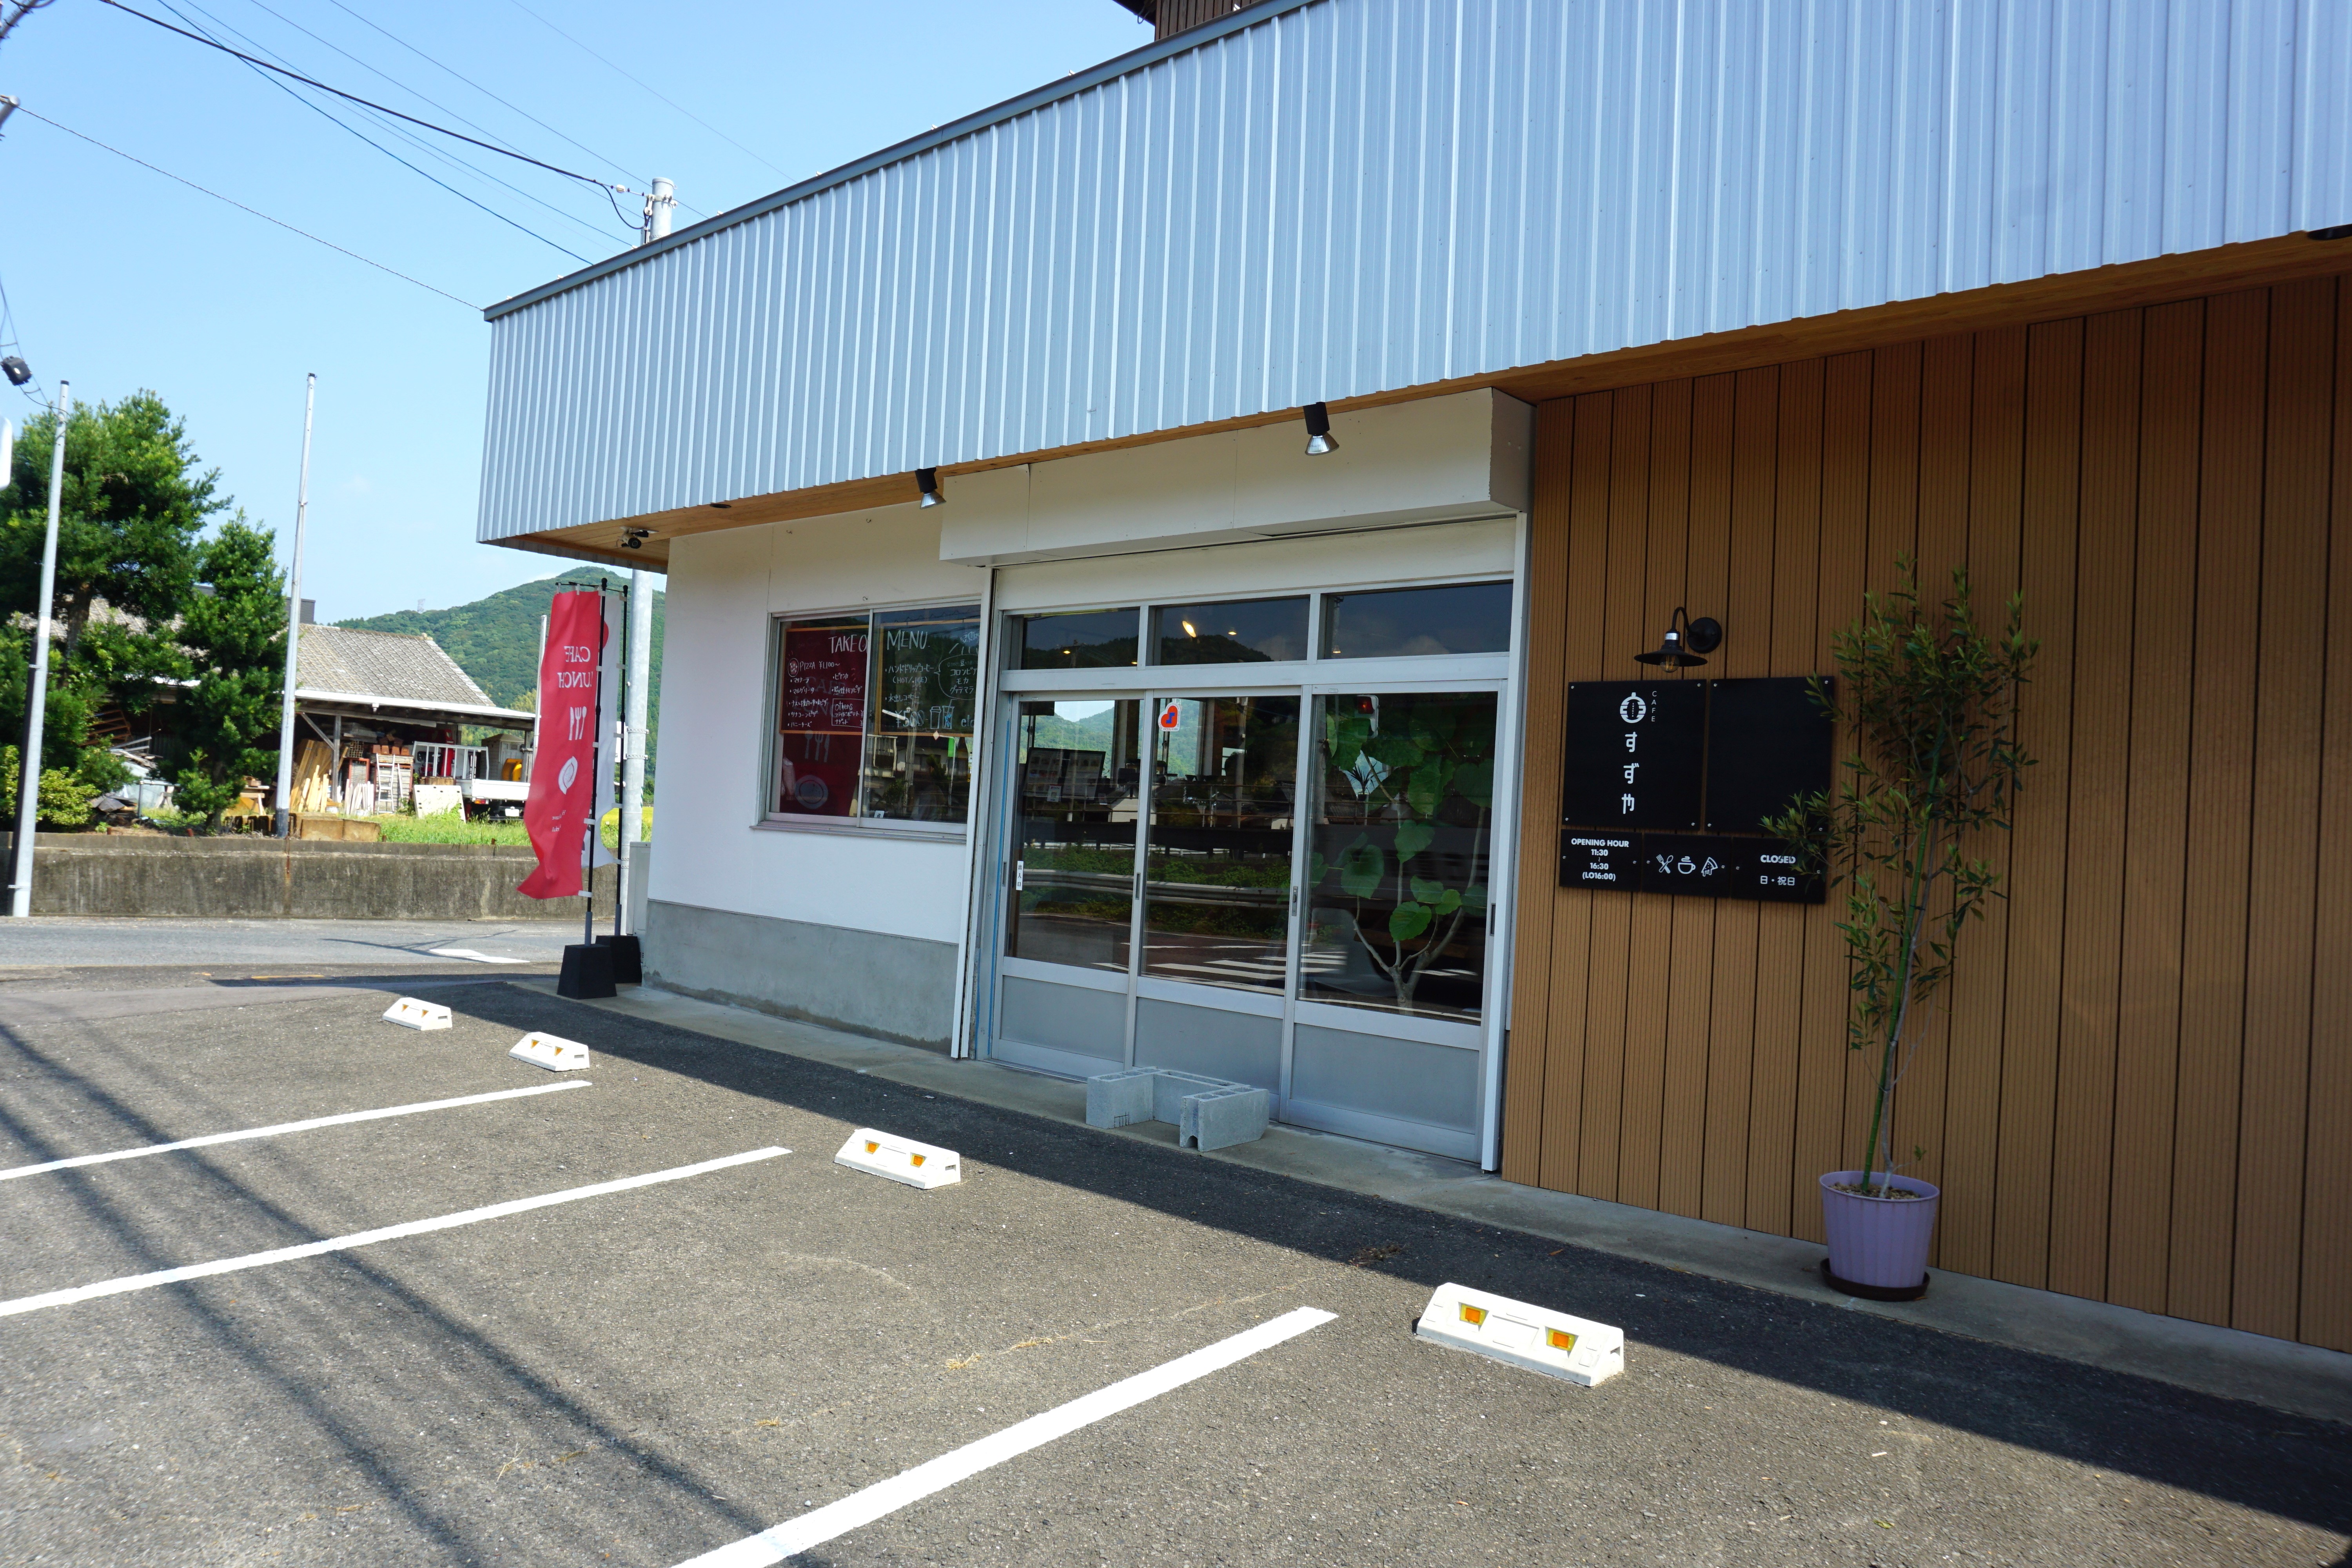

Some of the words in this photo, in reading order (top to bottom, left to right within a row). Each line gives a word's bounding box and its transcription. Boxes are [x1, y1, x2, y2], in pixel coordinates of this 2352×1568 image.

[828, 634, 857, 654] TAKE
[800, 661, 815, 671] PIZZA
[1621, 731, 1639, 814] すずや
[1571, 838, 1606, 846] OPENING
[1760, 855, 1796, 864] CLOSED
[1582, 871, 1616, 882] (LO16:00)
